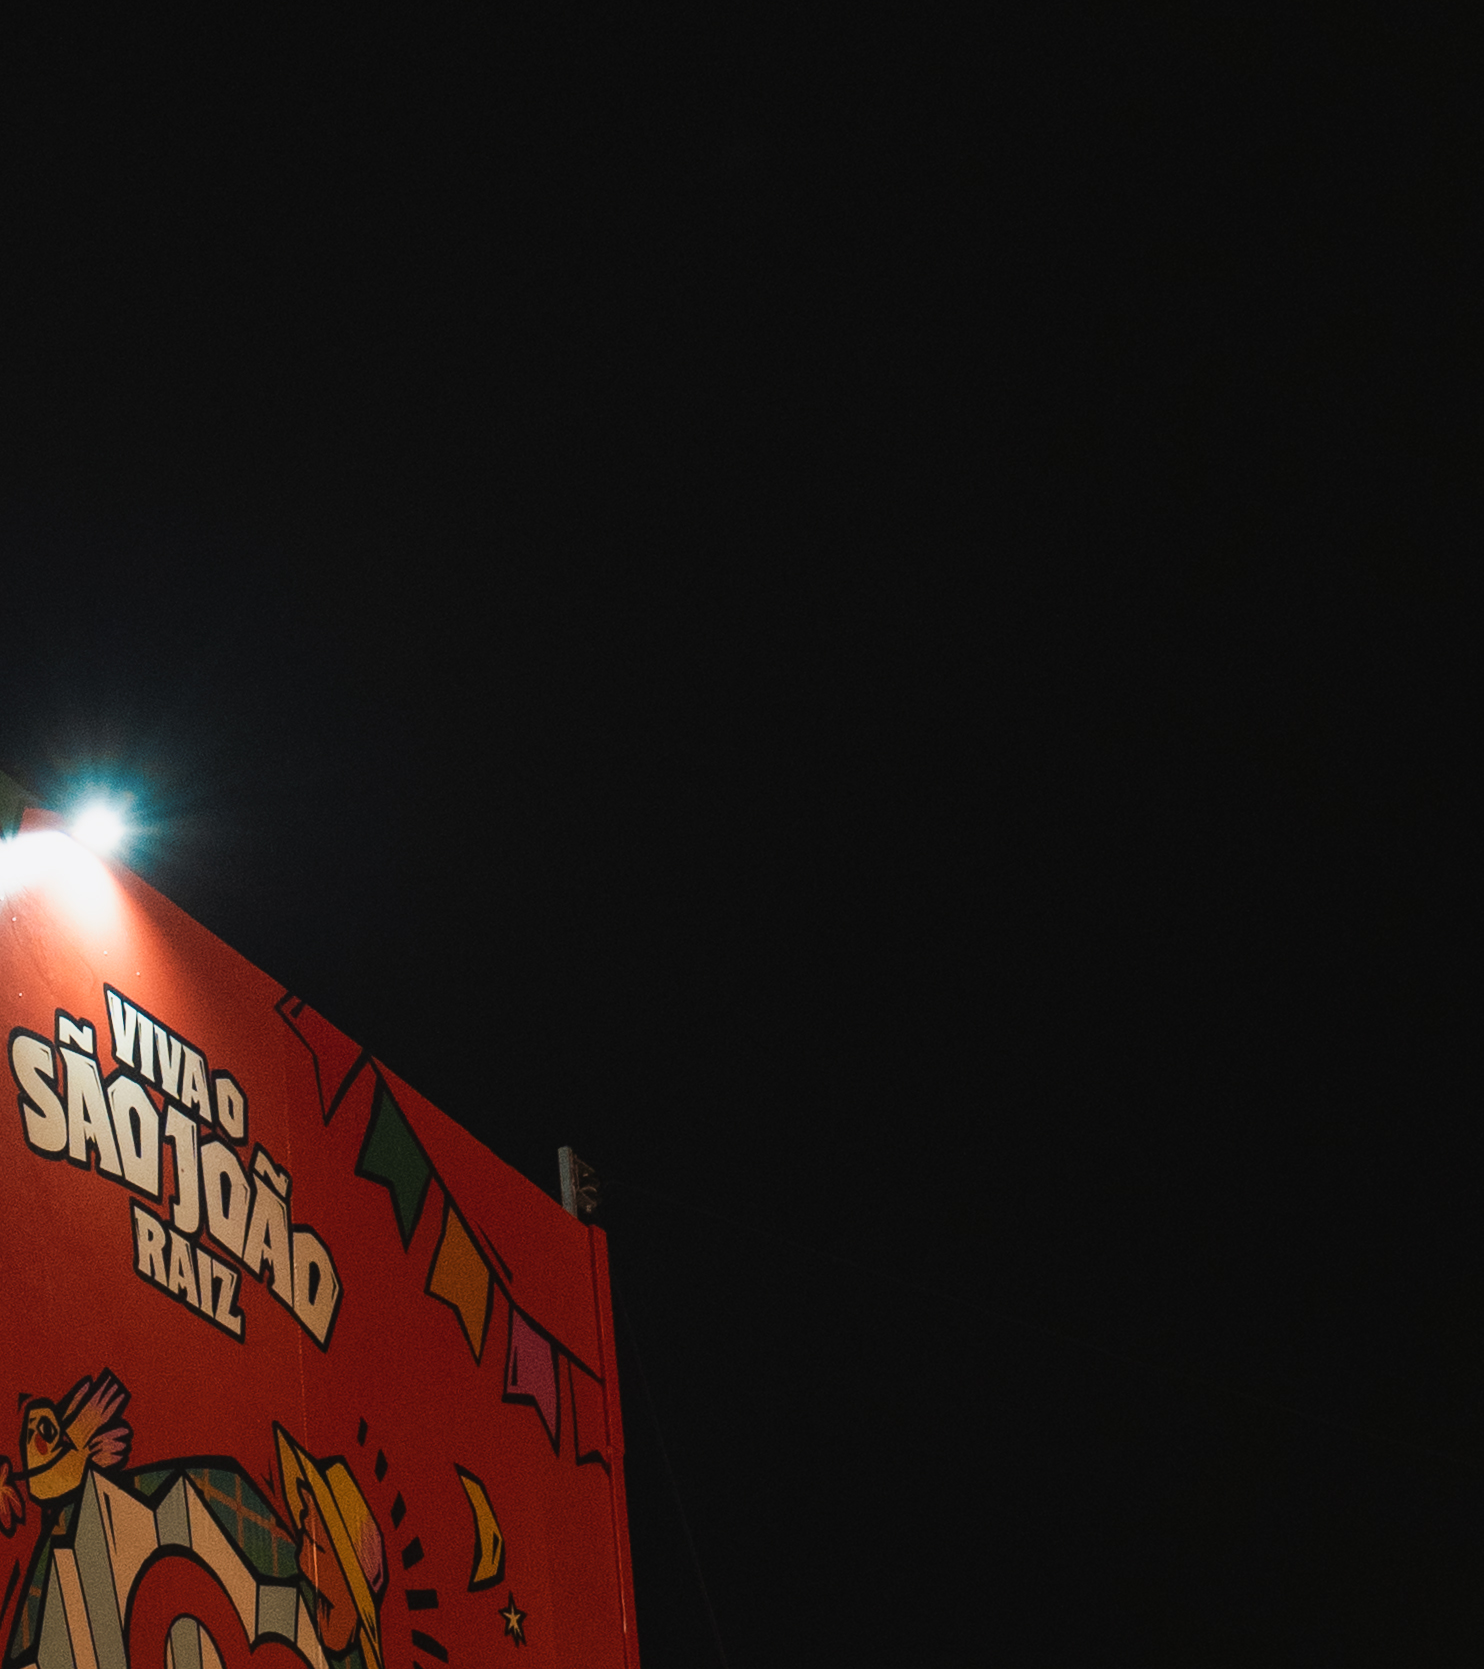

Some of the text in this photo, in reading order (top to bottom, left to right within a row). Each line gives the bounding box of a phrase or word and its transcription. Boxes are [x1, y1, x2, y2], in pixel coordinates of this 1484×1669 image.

[107, 989, 245, 1137] VIVA O
[10, 1014, 341, 1346] SÃO JOÃO
[134, 1205, 244, 1339] RAIZ
